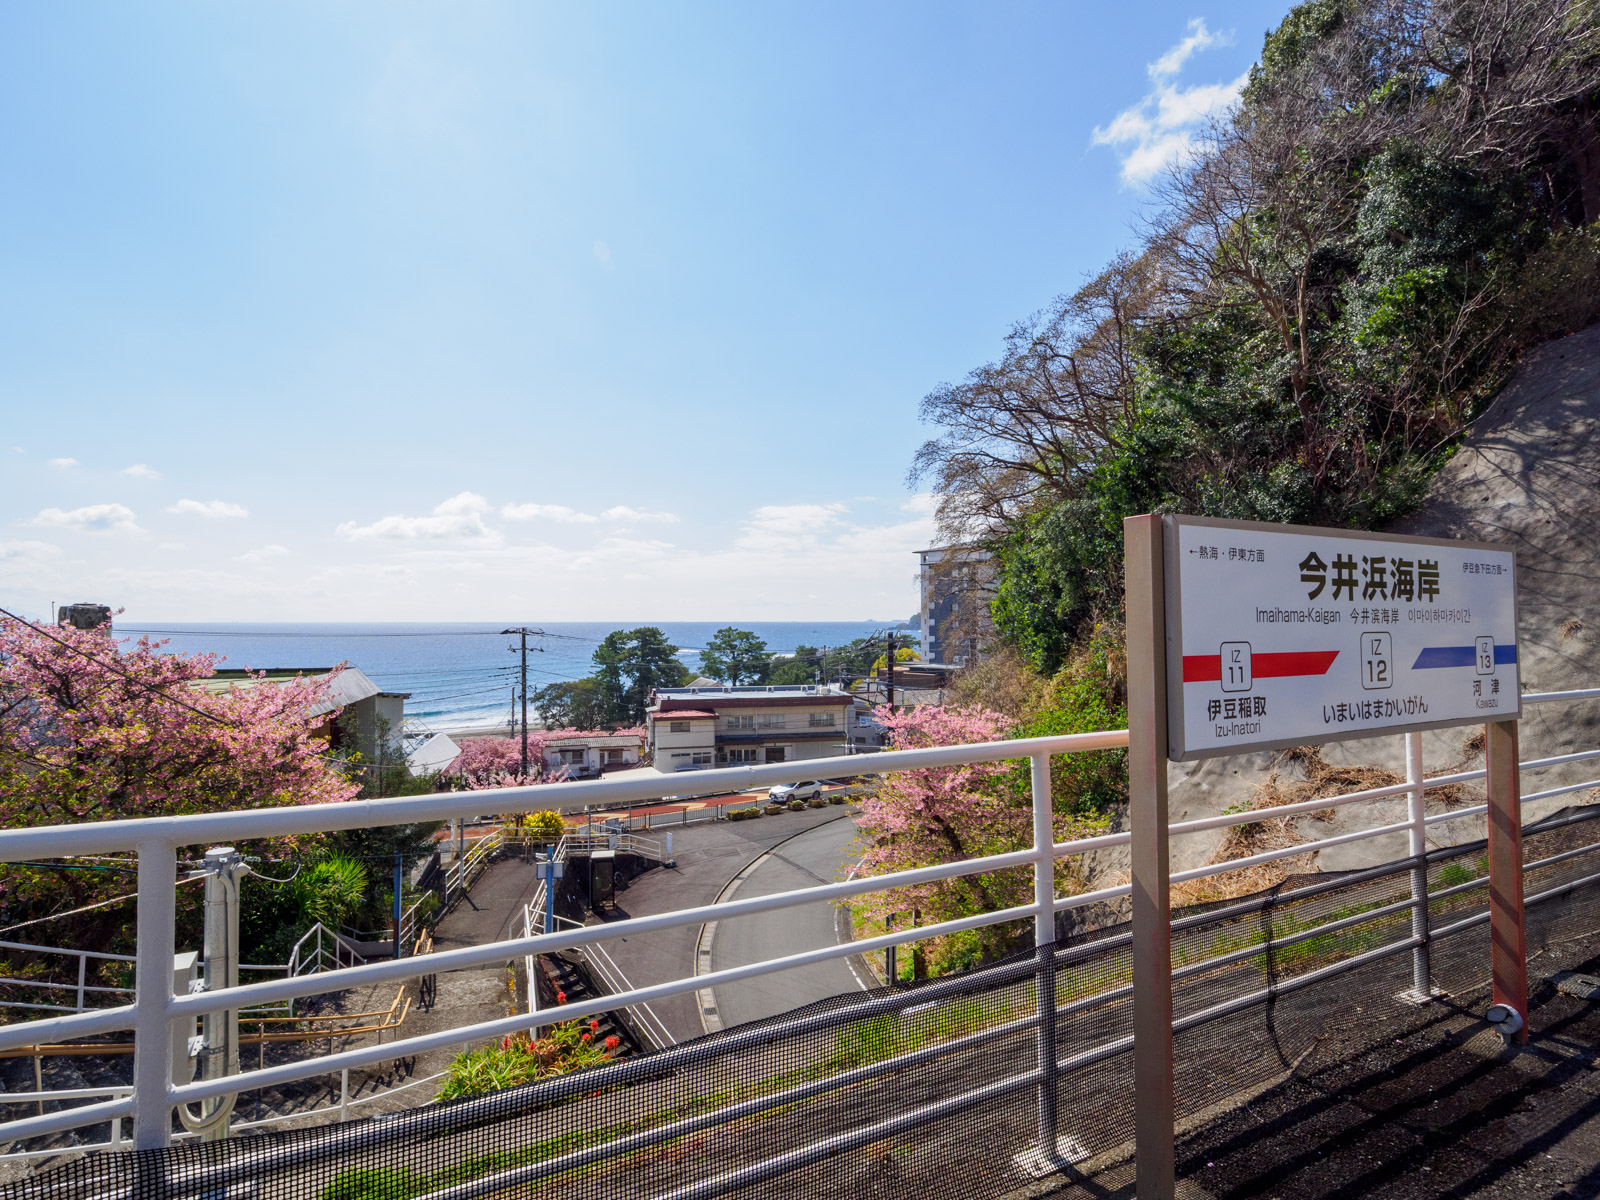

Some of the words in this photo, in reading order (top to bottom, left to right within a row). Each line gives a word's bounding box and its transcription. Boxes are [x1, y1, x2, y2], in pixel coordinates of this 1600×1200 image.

[1298, 551, 1441, 603] 今井浜海岸
[1255, 606, 1341, 625] Imaihama-Kaigan
[1350, 607, 1400, 625] 今井滨海岸
[1407, 608, 1472, 624] 이마이하마카이간
[1370, 638, 1383, 656] IZ
[1481, 642, 1489, 653] IZ
[1231, 649, 1242, 664] IZ
[1479, 655, 1491, 669] 13
[1228, 665, 1244, 684] 11
[1367, 659, 1388, 683] 12
[1207, 696, 1267, 722] 伊豆稲取
[1323, 695, 1429, 724] いまいはまかいがん
[1475, 698, 1499, 710] Kawazu
[1215, 719, 1262, 738] Izu-Inatori
